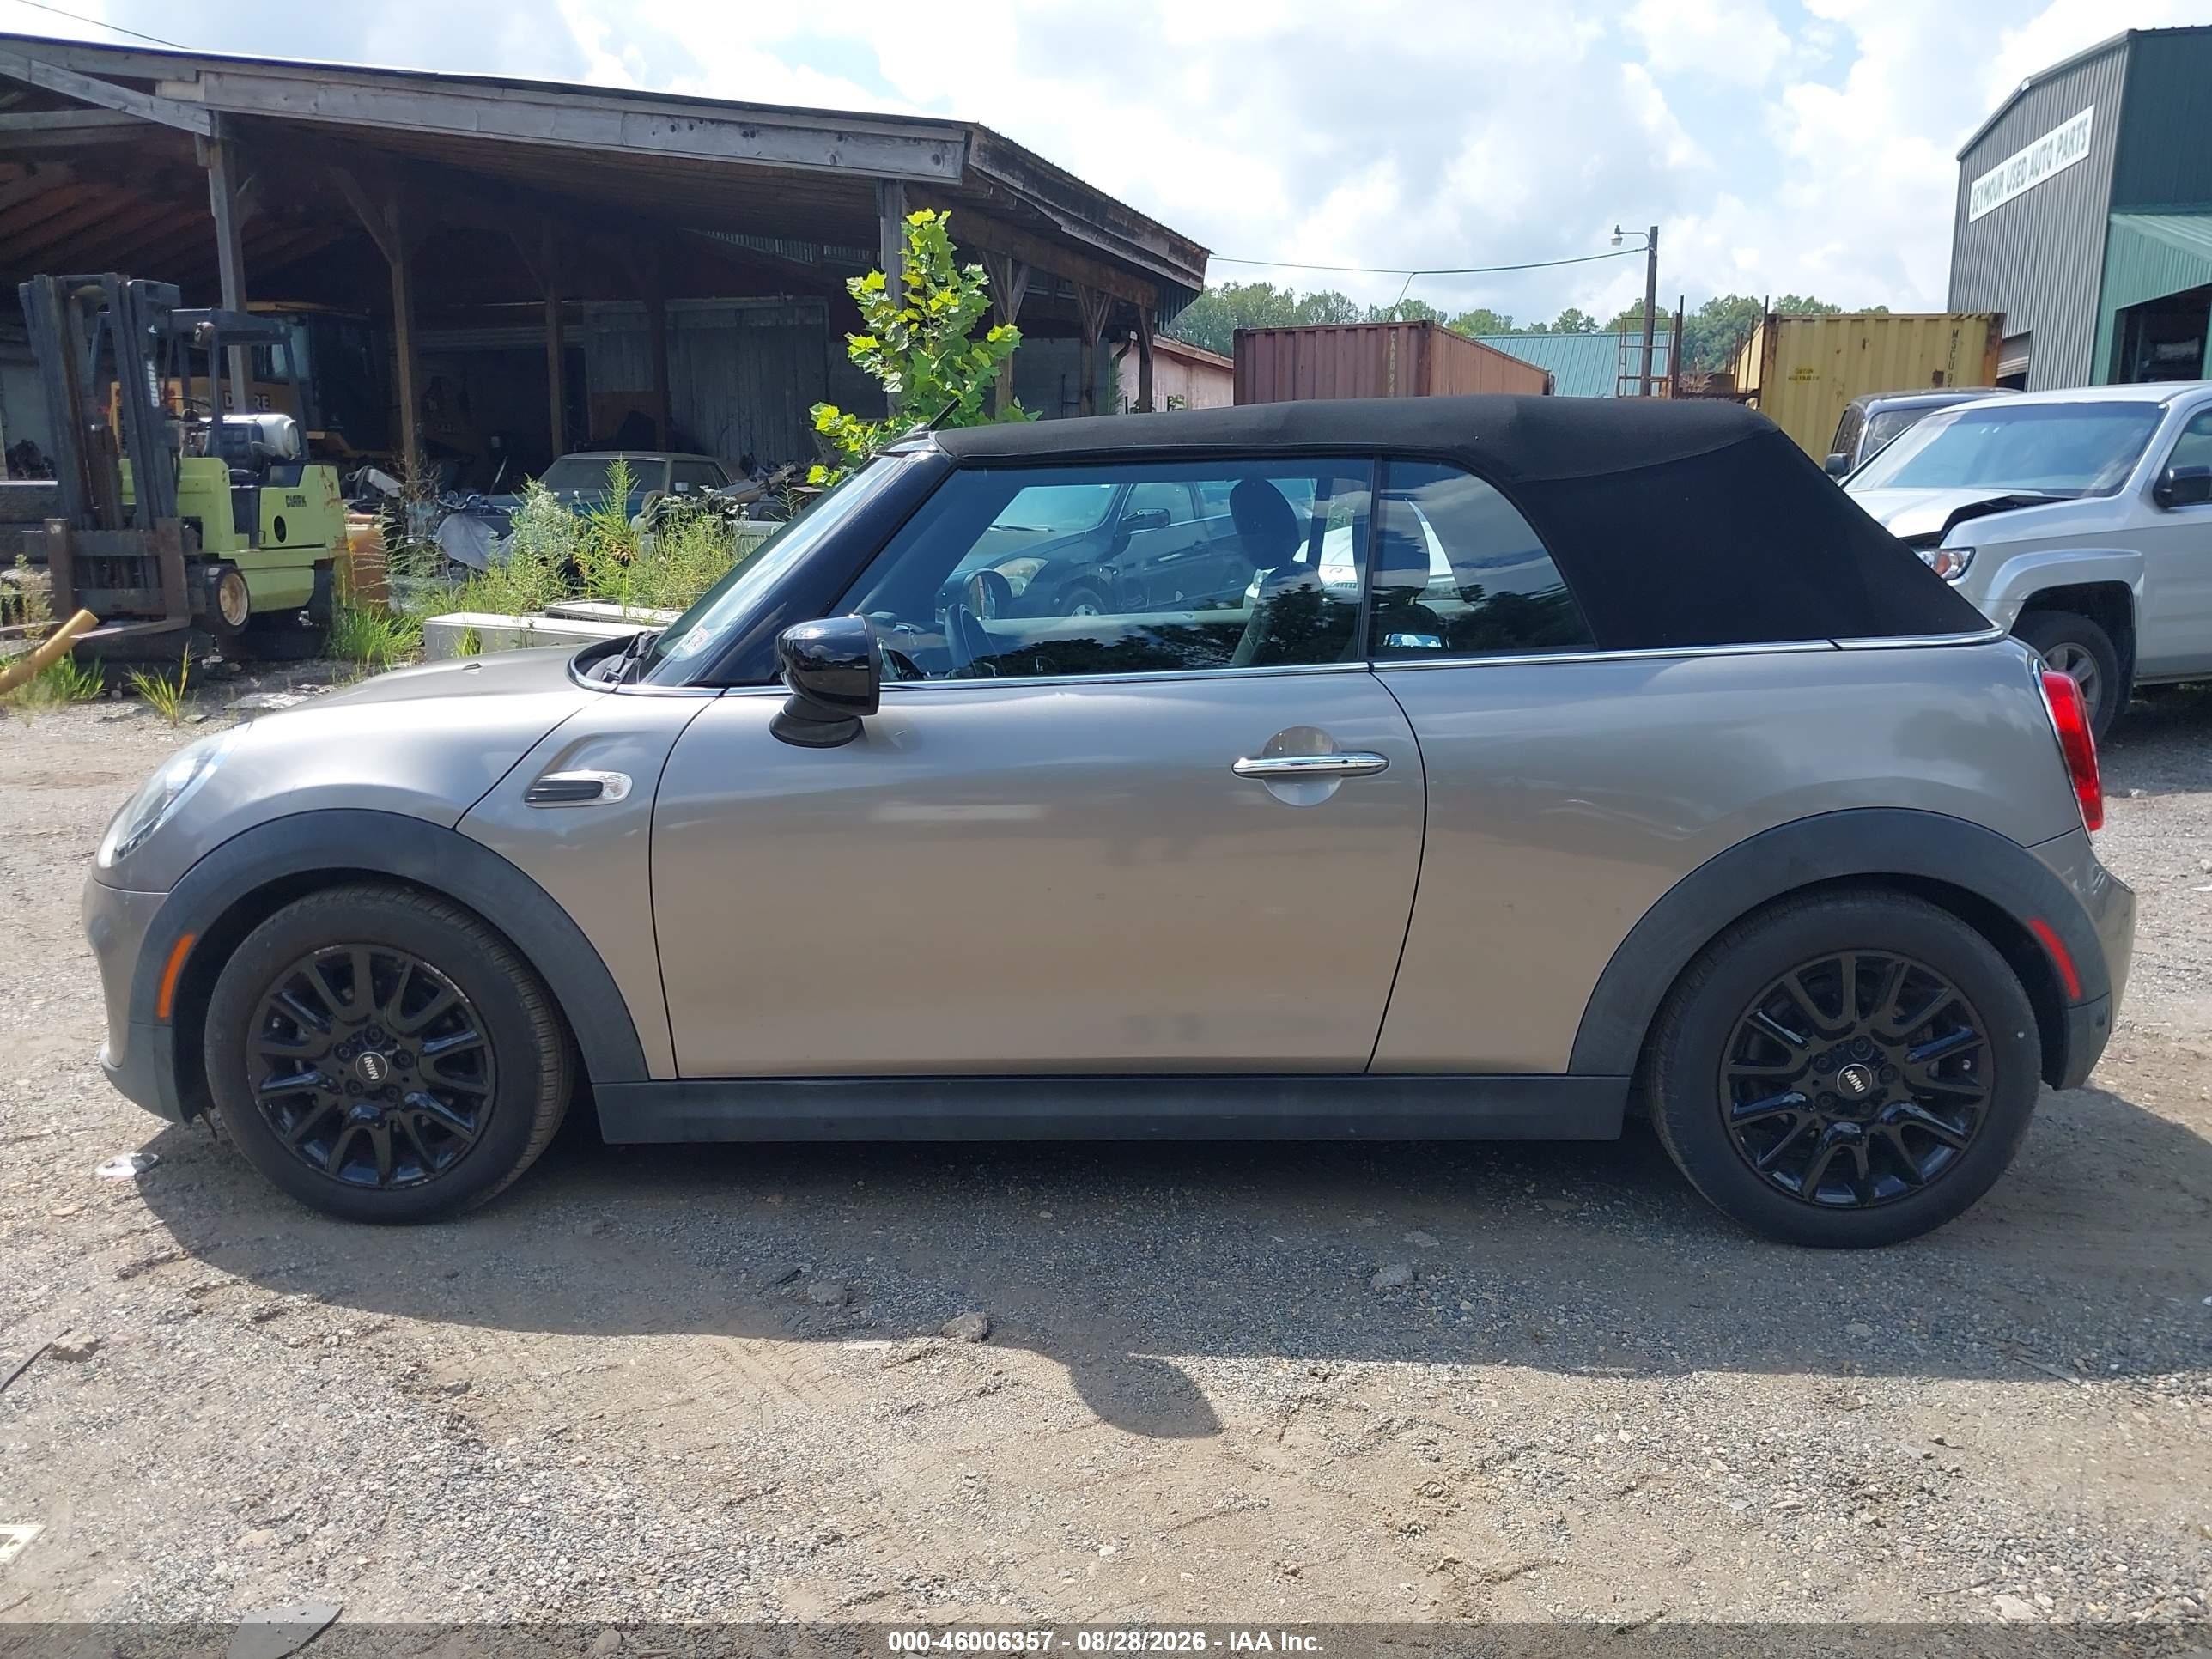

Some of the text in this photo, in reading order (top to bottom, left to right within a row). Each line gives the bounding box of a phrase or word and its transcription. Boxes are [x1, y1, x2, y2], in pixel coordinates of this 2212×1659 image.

[2007, 156, 2027, 193] USED
[2029, 139, 2054, 181] AUTO
[2056, 117, 2089, 165] PARTS
[146, 360, 160, 407] CLARK
[223, 391, 270, 412] DRE
[285, 495, 307, 507] CLARK
[363, 1056, 380, 1080] MINI
[1844, 1069, 1866, 1093] MINI
